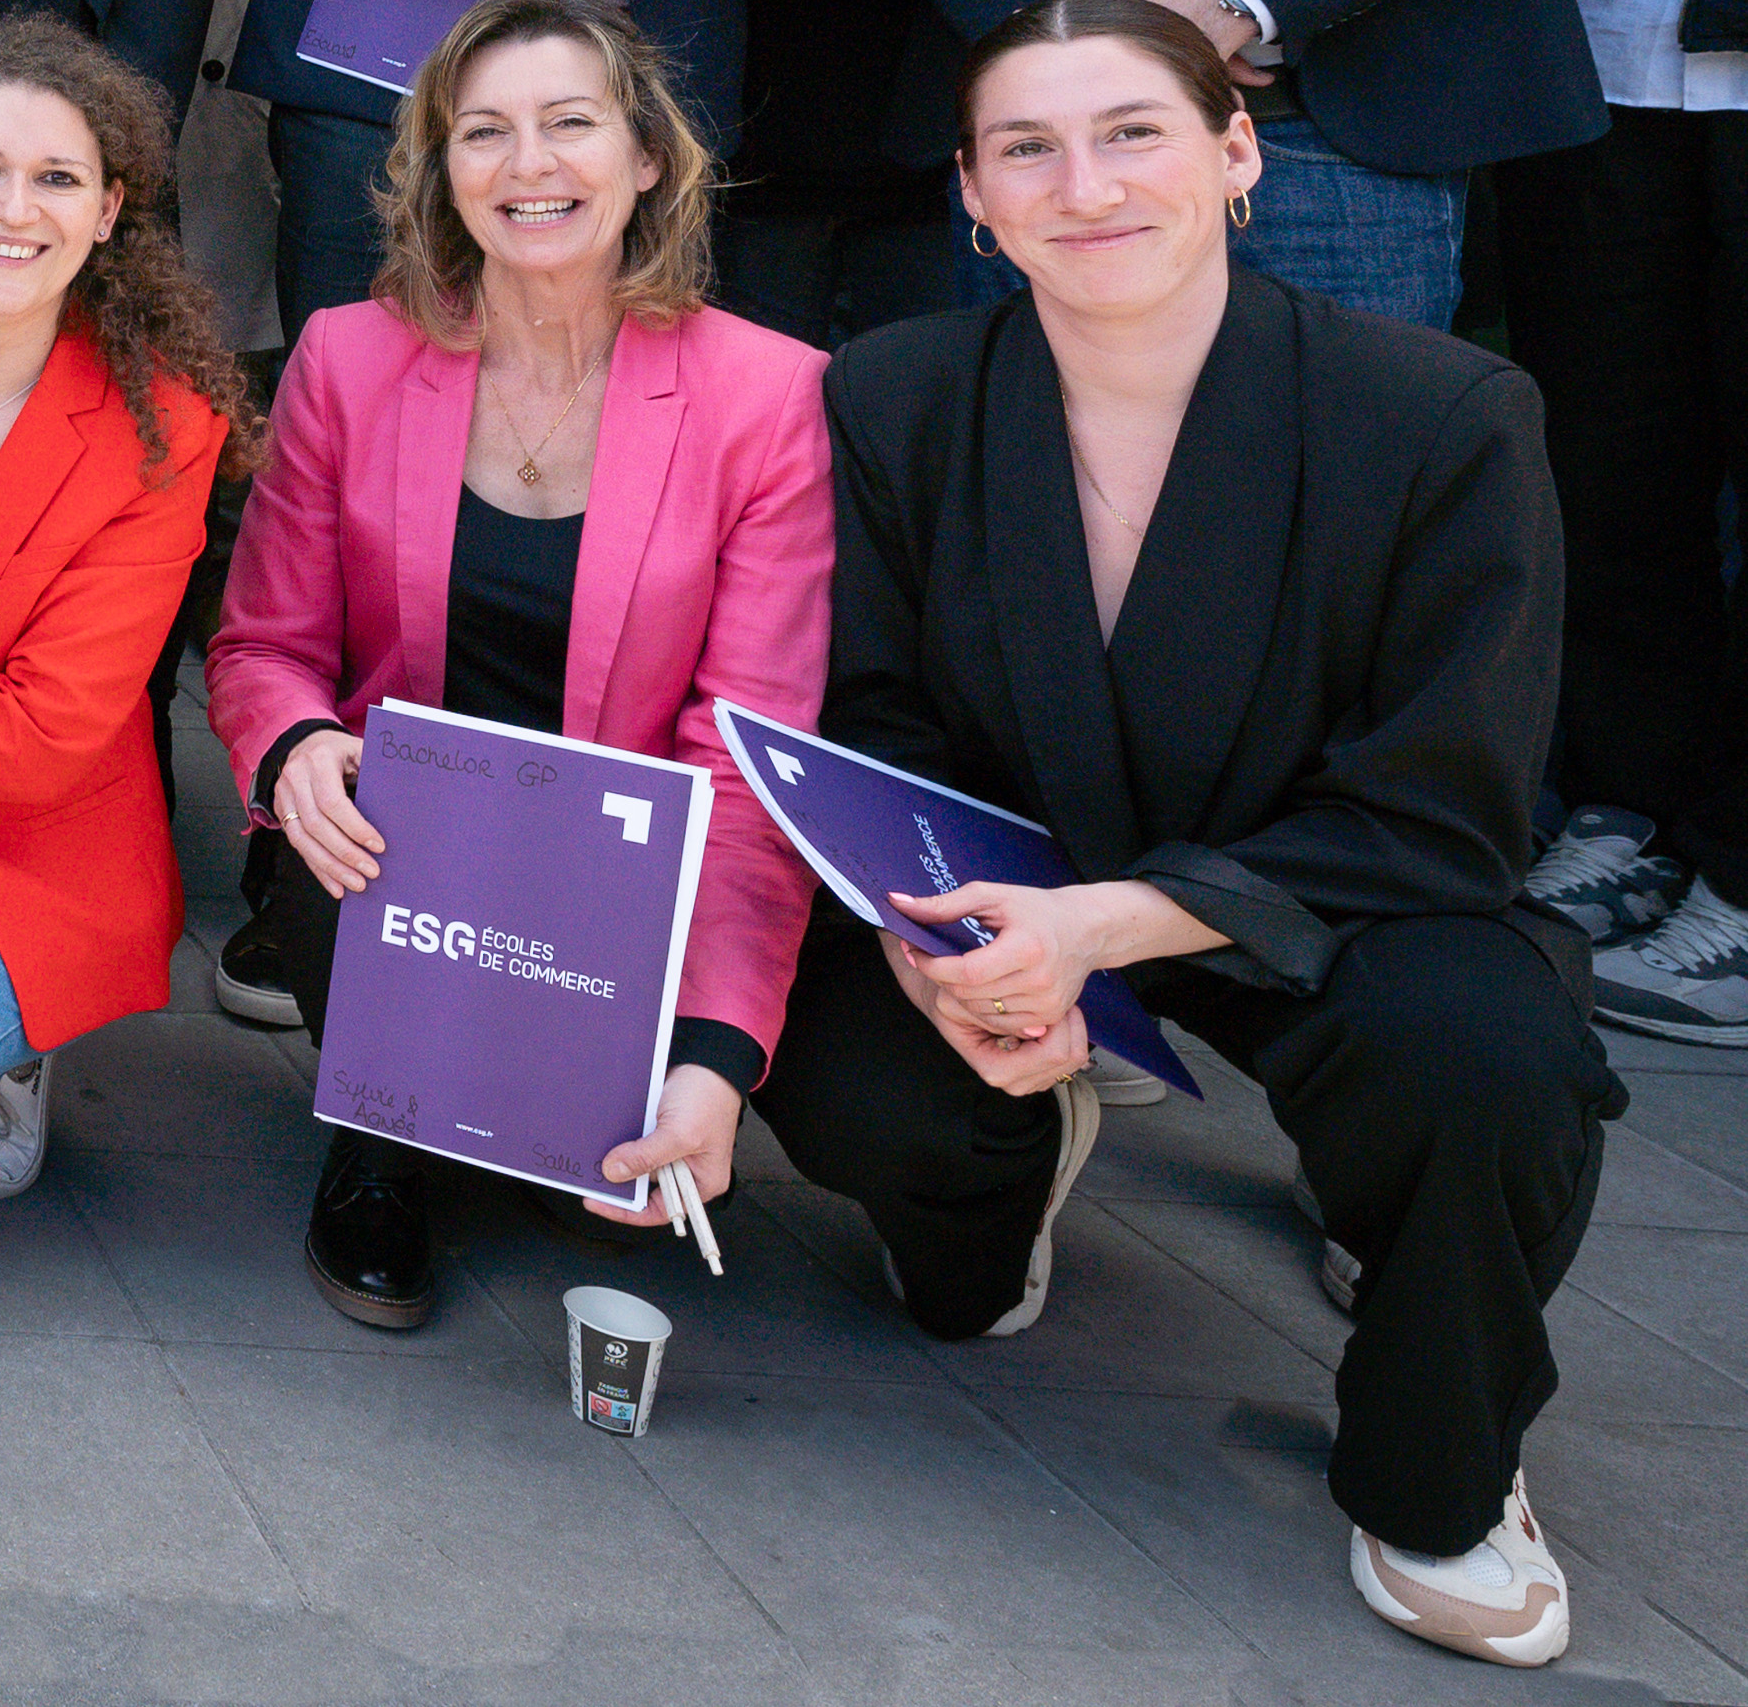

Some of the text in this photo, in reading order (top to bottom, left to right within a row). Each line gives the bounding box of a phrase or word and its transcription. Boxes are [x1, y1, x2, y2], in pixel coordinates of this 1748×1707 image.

[516, 761, 558, 789] GP
[381, 903, 555, 962] ESG ÉCOLES
[478, 950, 616, 1000] DE COMMERCE
[333, 1070, 395, 1109] Sylvie
[353, 1101, 416, 1139] Agnès
[455, 1122, 494, 1139] www.esg.fr
